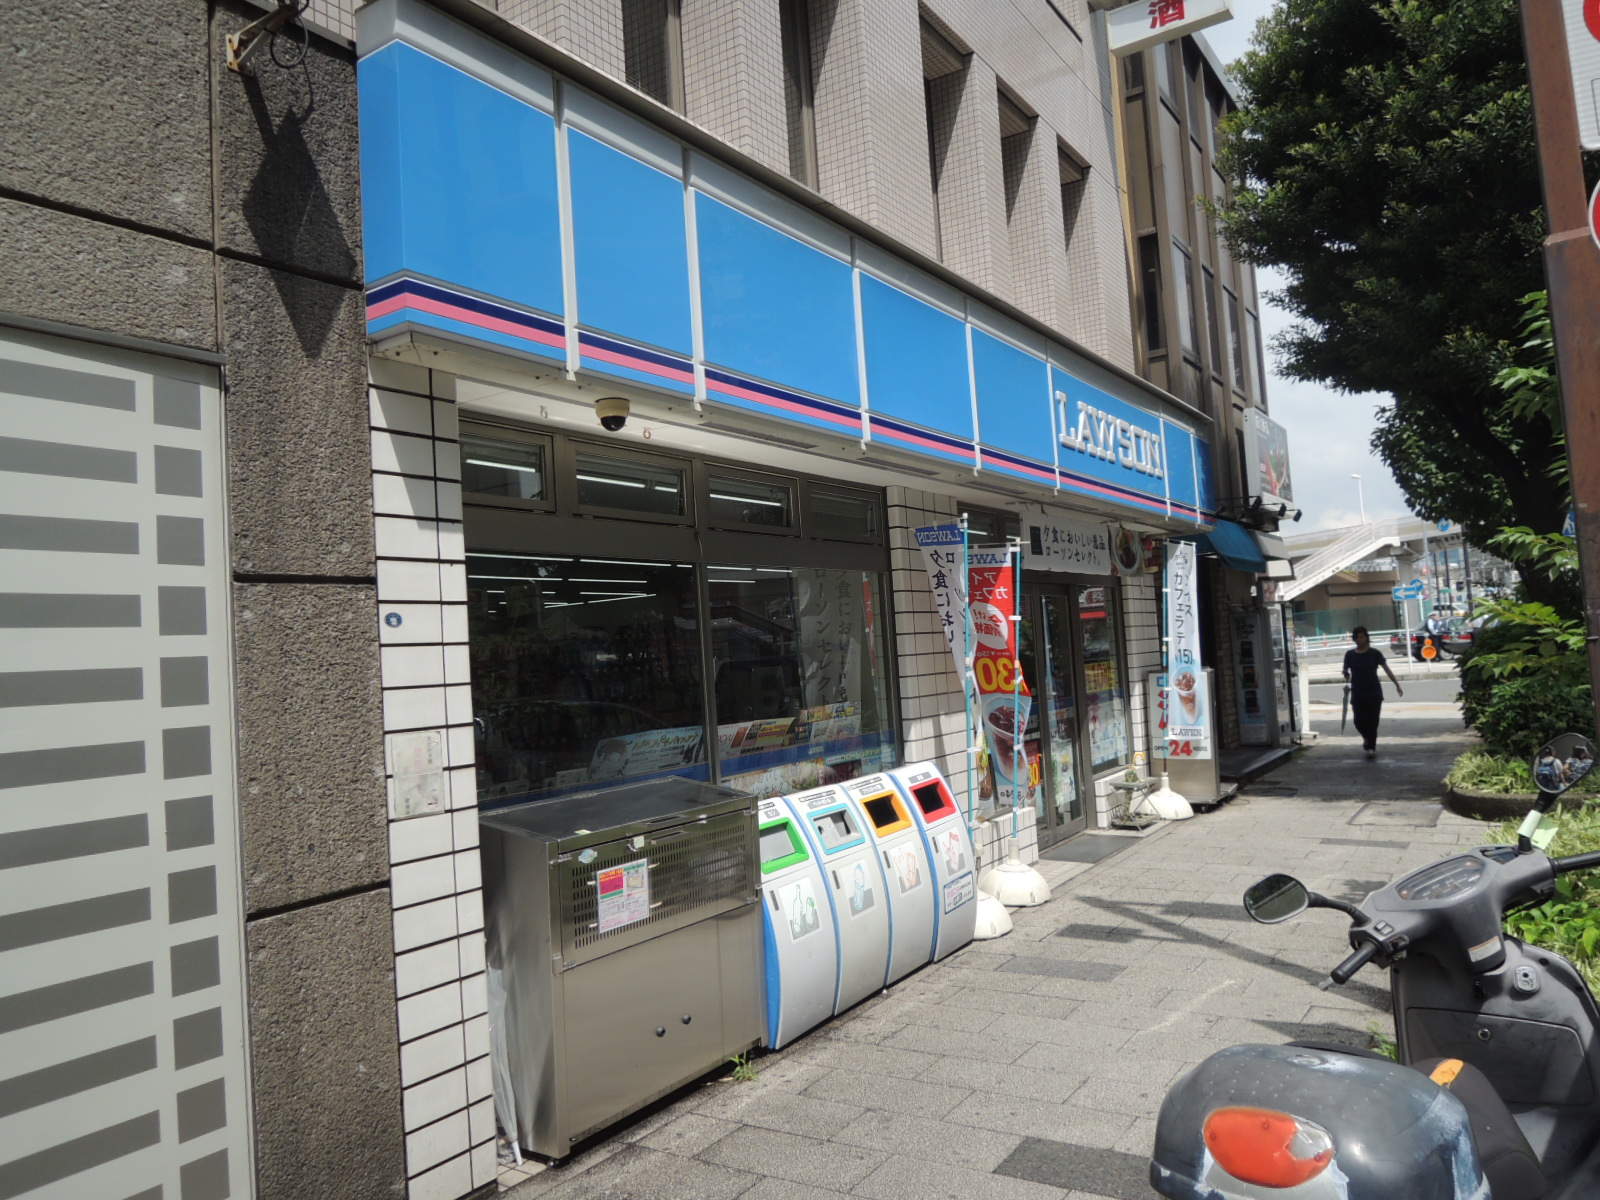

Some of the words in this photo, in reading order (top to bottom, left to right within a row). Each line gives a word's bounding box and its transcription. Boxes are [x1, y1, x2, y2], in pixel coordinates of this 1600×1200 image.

[1148, 0, 1186, 29] 酒
[1055, 389, 1164, 480] LAWSON
[1174, 572, 1186, 645] カフェラテ
[1169, 740, 1193, 757] 24
